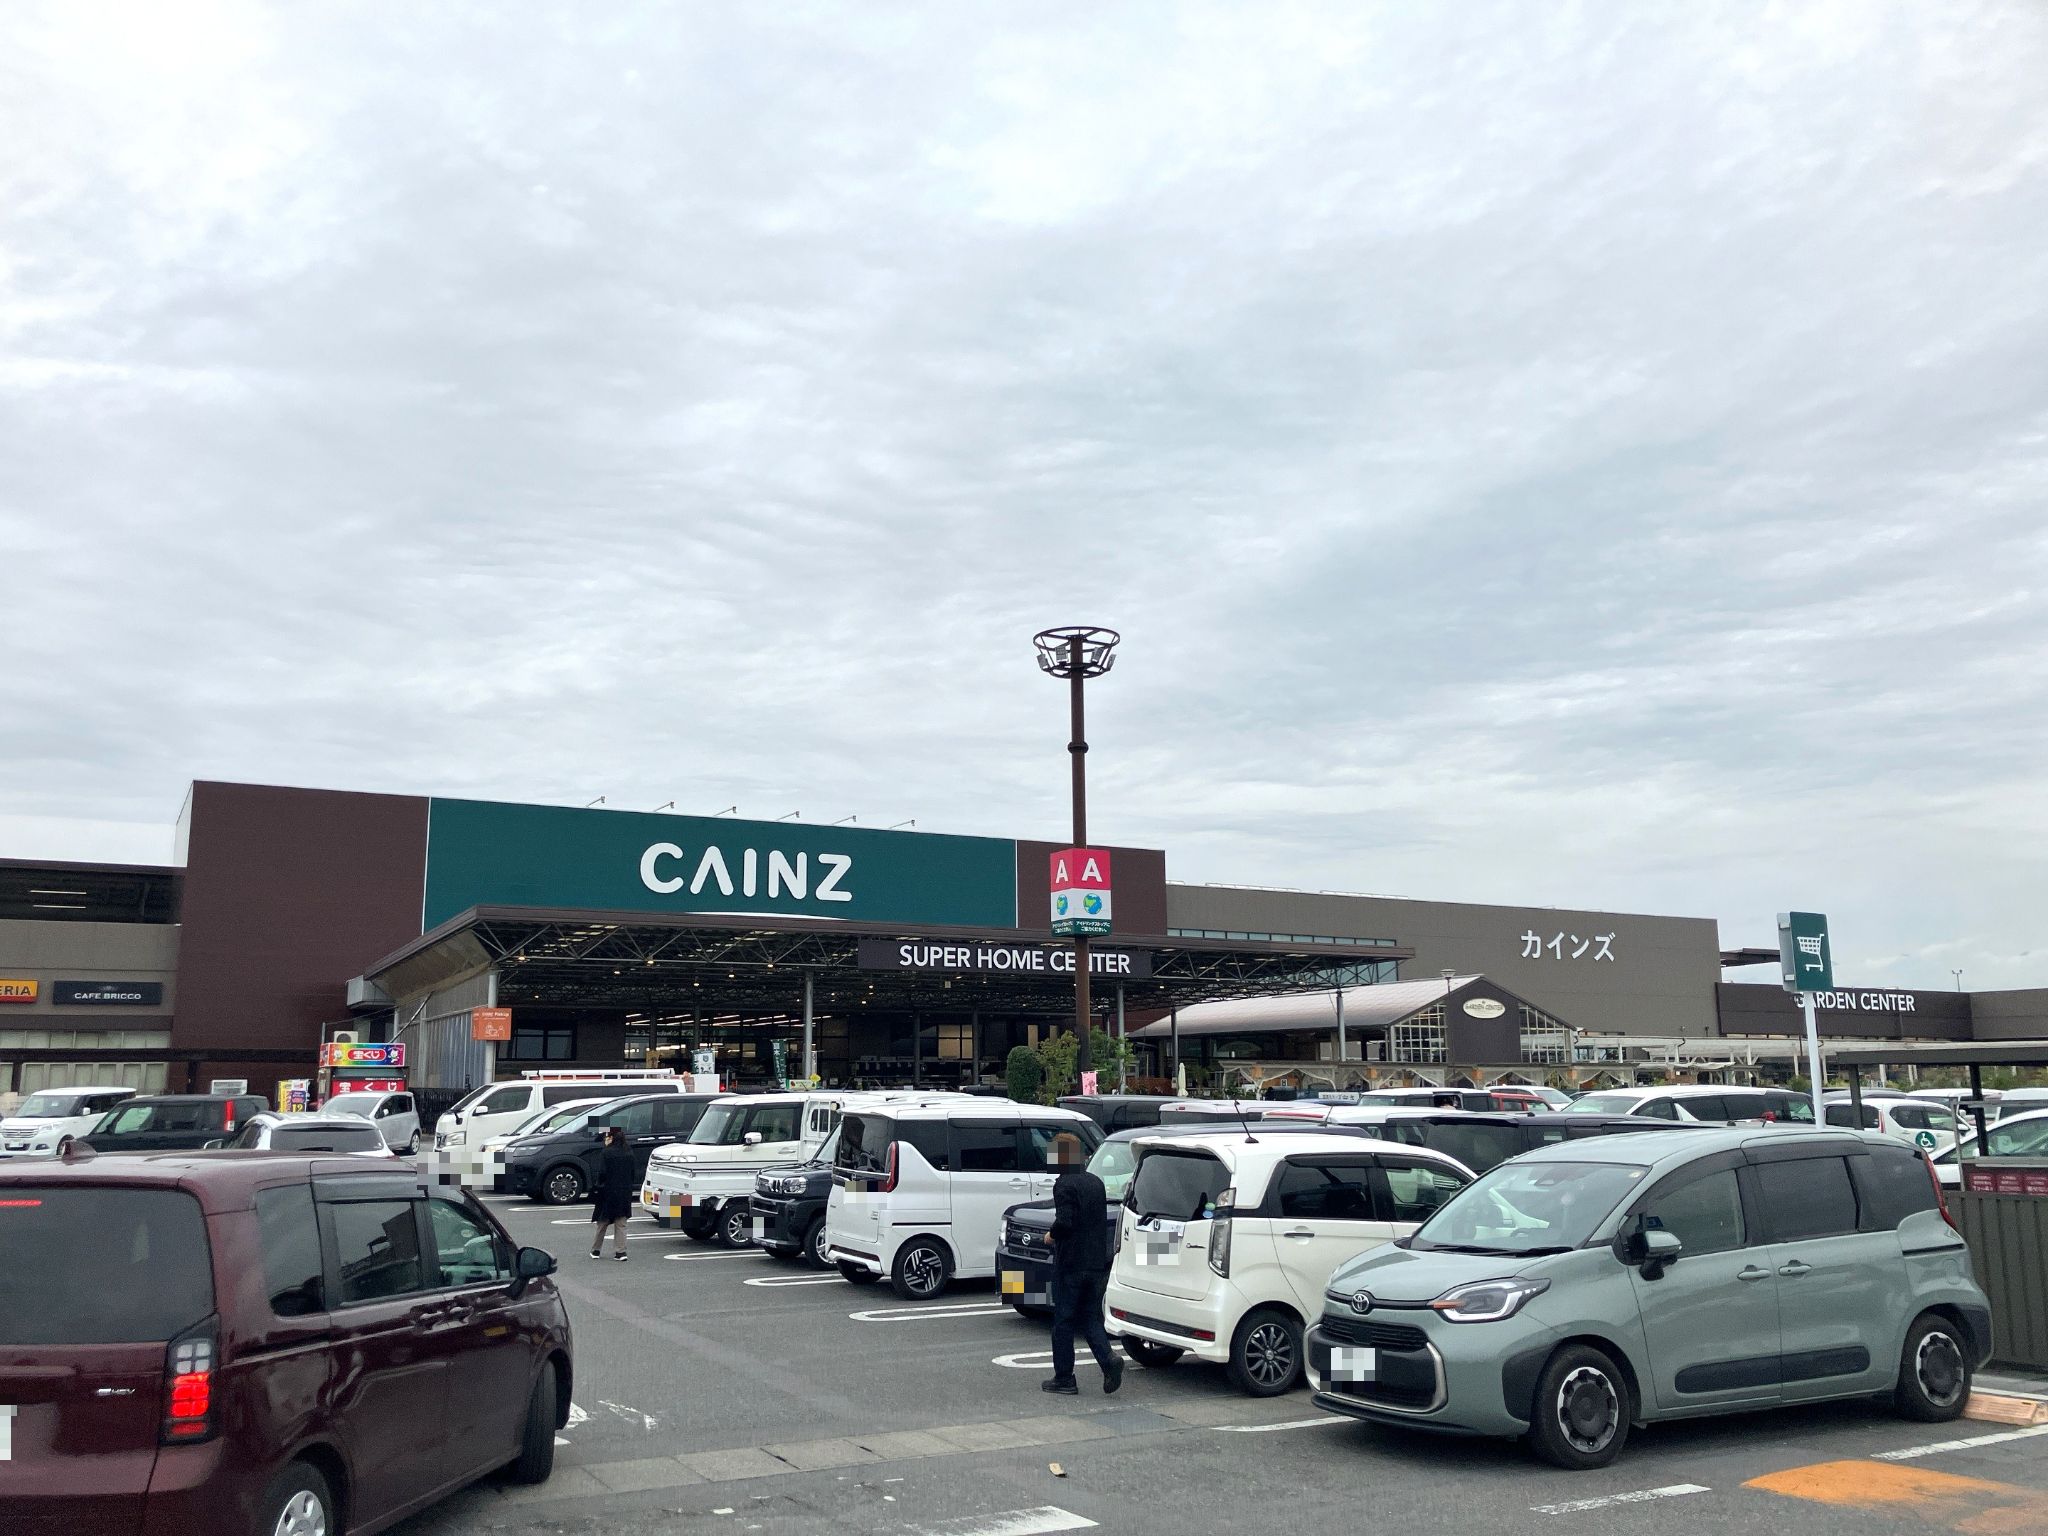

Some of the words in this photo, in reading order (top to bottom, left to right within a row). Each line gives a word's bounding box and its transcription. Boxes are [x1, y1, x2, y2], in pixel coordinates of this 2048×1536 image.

[640, 842, 853, 902] CAINZ
[1055, 859, 1069, 884] A
[1081, 857, 1103, 883] A
[1520, 929, 1616, 962] カインズ
[899, 945, 971, 968] SUPER
[977, 948, 1044, 970] HOME
[1049, 950, 1131, 974] CETER
[103, 992, 142, 1000] BRICCO
[1860, 993, 1916, 1012] CENTER
[353, 1050, 380, 1060] 宝くじ
